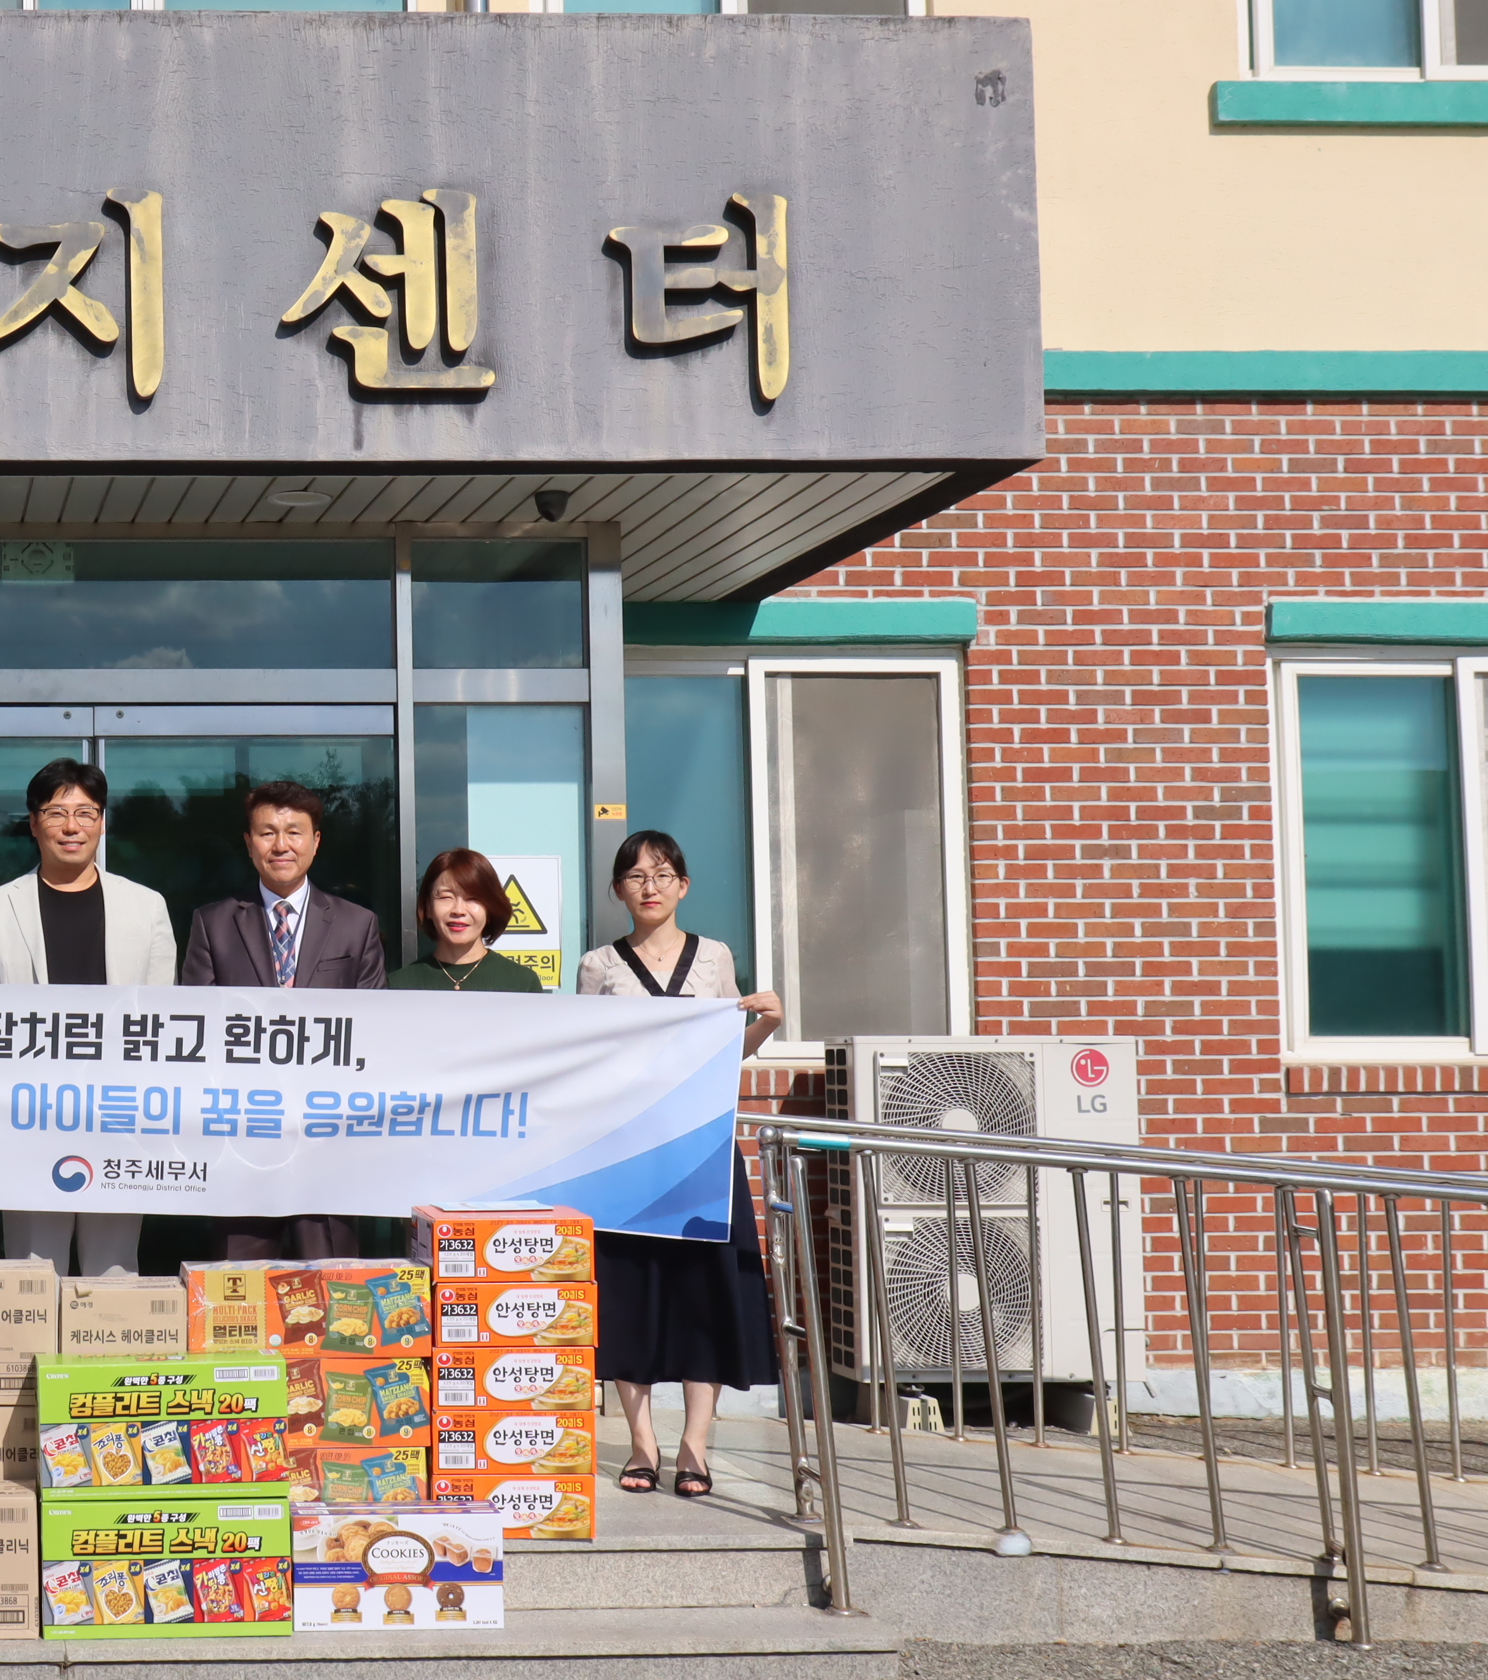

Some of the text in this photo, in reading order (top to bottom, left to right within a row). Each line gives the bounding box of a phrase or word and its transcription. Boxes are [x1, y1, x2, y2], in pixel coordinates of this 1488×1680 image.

[121, 1012, 207, 1063] 밝고
[223, 1013, 366, 1072] 환하게,
[11, 1081, 181, 1136] 아이들의
[200, 1087, 285, 1139] 꿈을
[302, 1090, 529, 1139] 응원합니다!
[1076, 1094, 1108, 1114] LG
[102, 1158, 208, 1182] 청주세무서
[118, 1182, 154, 1191] Cheongju
[156, 1183, 182, 1191] District
[453, 1226, 475, 1236] 농심
[439, 1239, 474, 1251] 가3632
[492, 1237, 554, 1254] 안성탕면
[398, 1269, 425, 1281] 25팩
[283, 1289, 316, 1303] GARLIC
[455, 1291, 478, 1301] 농심
[333, 1303, 369, 1314] CORN CHIP
[442, 1304, 476, 1315] 가3632
[495, 1302, 556, 1318] 안성탕면
[70, 1329, 179, 1344] 케라시스 헤어클리닉
[213, 1325, 257, 1338] 멀티팩
[397, 1360, 424, 1371] 25팩
[453, 1355, 475, 1365] 농심
[439, 1368, 473, 1379] 가3632
[492, 1366, 554, 1383] 안성탕면
[124, 1376, 148, 1386] 완벽한
[167, 1375, 184, 1384] 구성
[69, 1388, 259, 1419] 컴플리트 스낵 20팩
[333, 1394, 368, 1404] CORN CHIP
[453, 1418, 475, 1428] 농심
[93, 1432, 125, 1450] 죠리퐁
[439, 1431, 474, 1442] 가3632
[493, 1429, 555, 1446] 안성탕면
[394, 1450, 421, 1460] 25팩
[329, 1484, 364, 1493] CORN CHIP
[451, 1483, 473, 1492] 농심
[492, 1494, 553, 1510] 안성탕면
[127, 1514, 152, 1523] 완벽한
[170, 1513, 187, 1522] 구성
[71, 1526, 262, 1556] 컴플리트 스낵 20팩
[95, 1570, 127, 1588] 죠리퐁
[370, 1574, 402, 1583] ORIGINAL
